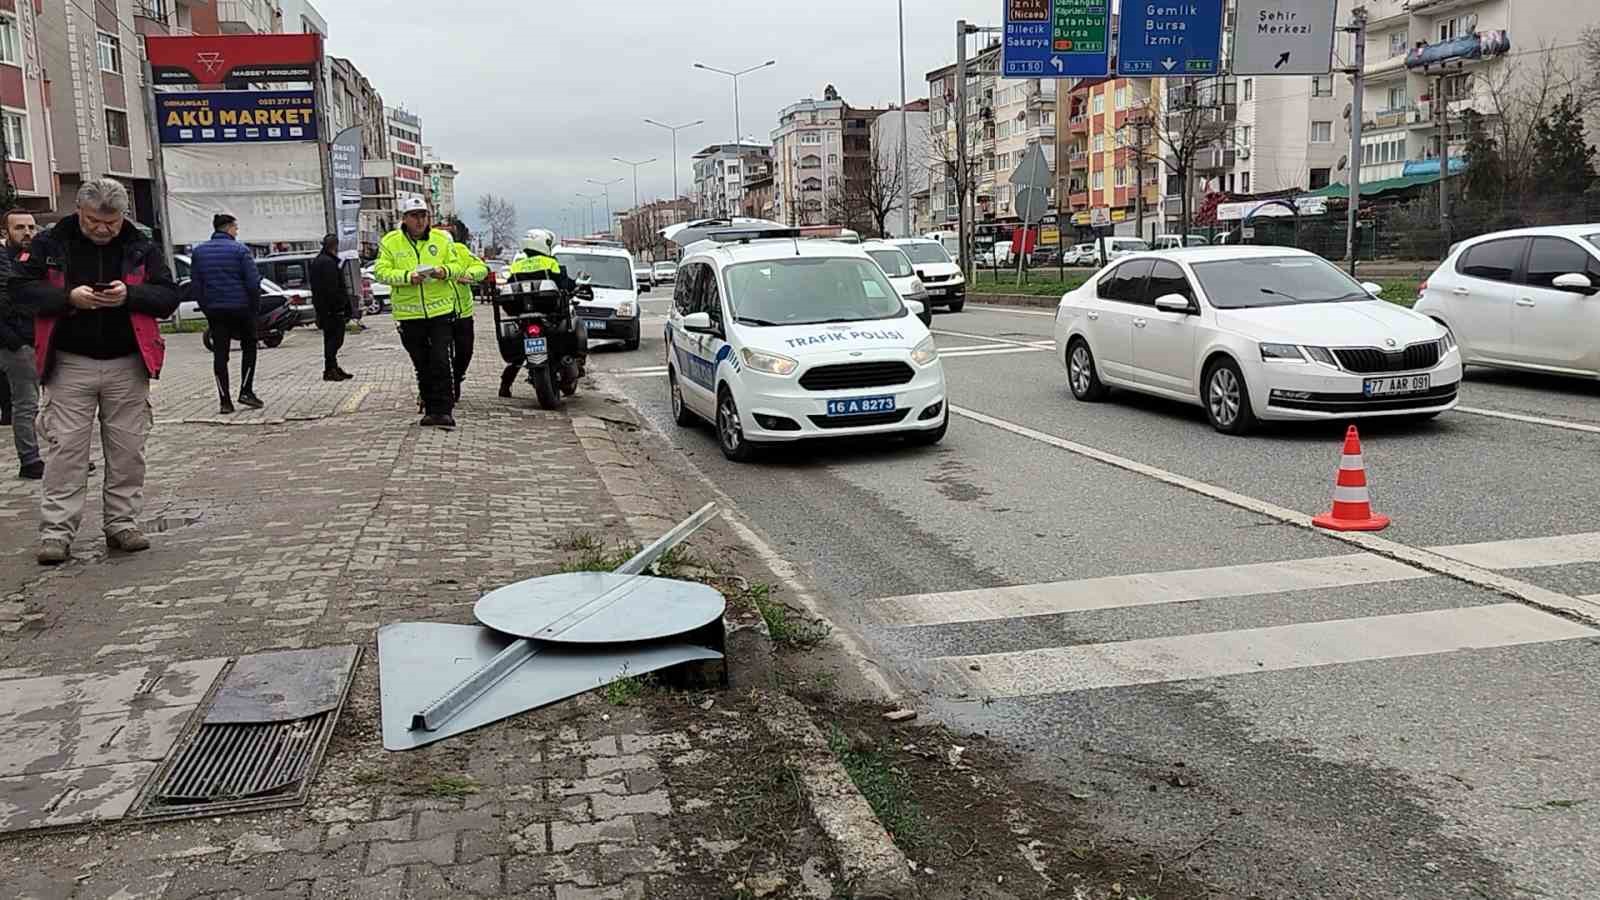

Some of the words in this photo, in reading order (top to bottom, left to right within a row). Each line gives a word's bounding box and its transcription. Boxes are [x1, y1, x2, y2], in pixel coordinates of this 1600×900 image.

[1146, 5, 1198, 16] Gemlik
[1259, 10, 1297, 22] Şehir
[1007, 25, 1045, 34] Bilecik
[1145, 20, 1186, 31] Bursa
[1257, 24, 1312, 34] Merkezi
[1055, 29, 1089, 37] Bursa
[1007, 37, 1049, 48] Sakarya
[1144, 34, 1185, 45] İzmir
[166, 107, 213, 126] AKÜ
[219, 108, 313, 126] MARKET
[785, 332, 848, 348] TRAFİK
[1372, 380, 1384, 392] 77
[1390, 378, 1409, 390] AAR
[1412, 376, 1428, 389] 091
[828, 402, 845, 413] 16
[848, 401, 859, 412] A
[862, 399, 894, 411] 8273
